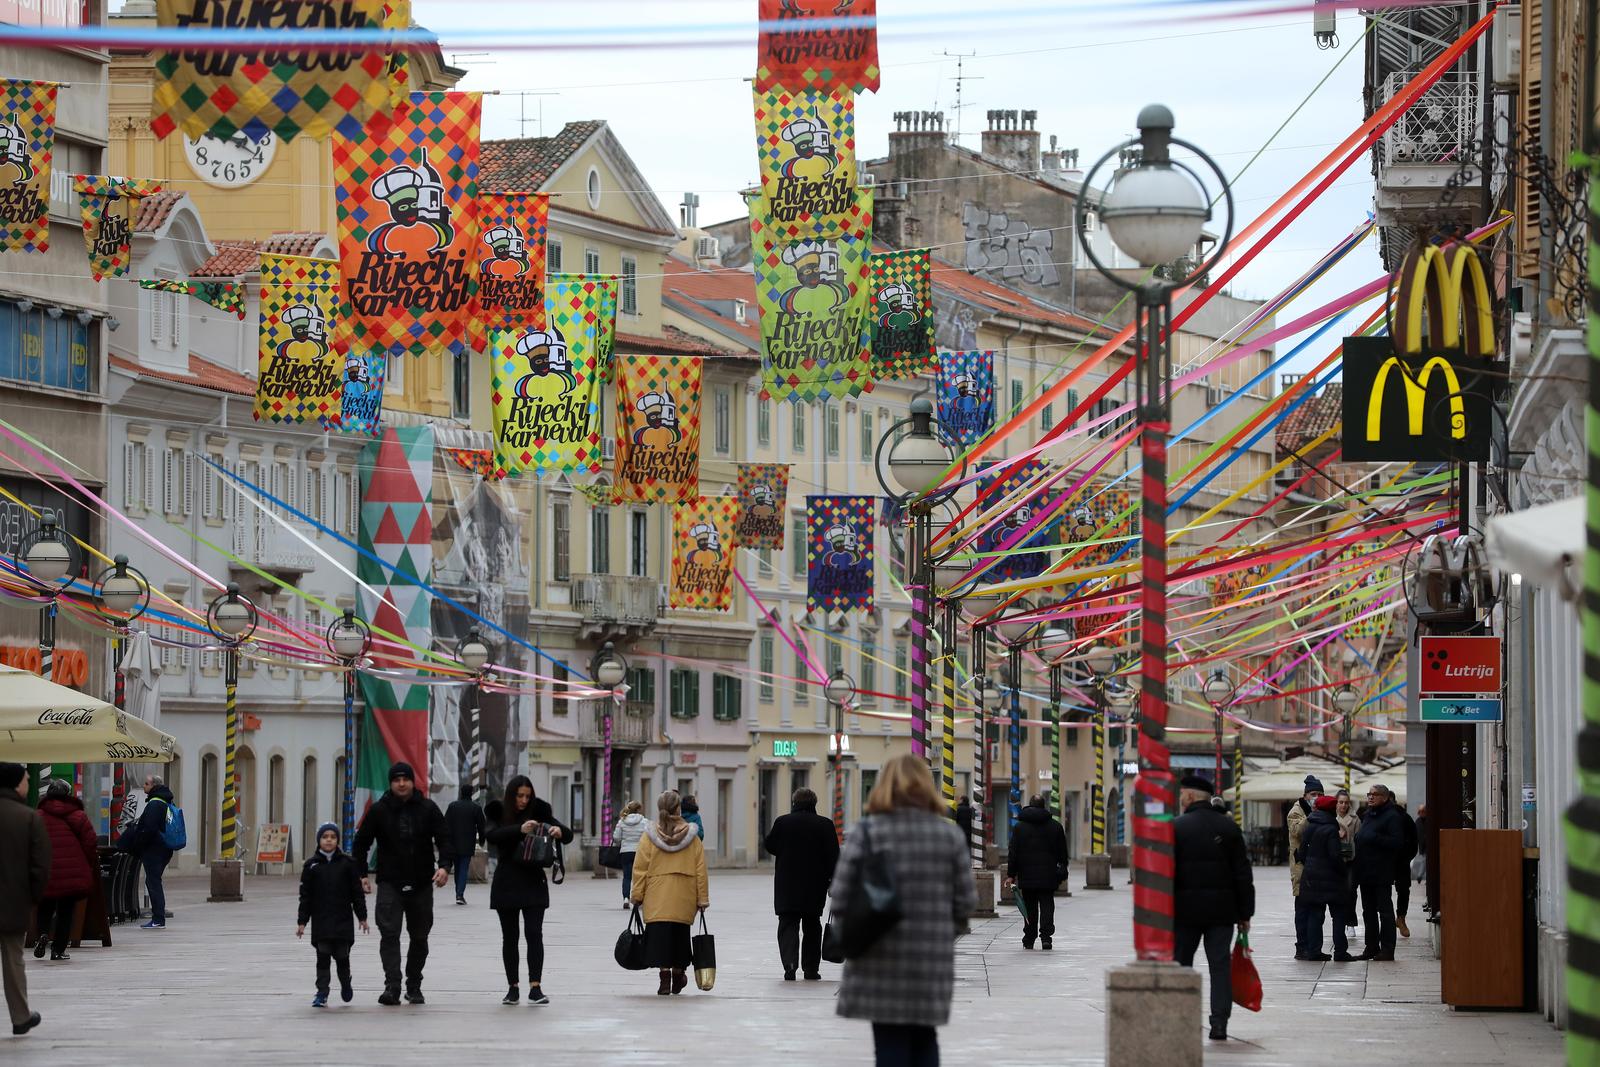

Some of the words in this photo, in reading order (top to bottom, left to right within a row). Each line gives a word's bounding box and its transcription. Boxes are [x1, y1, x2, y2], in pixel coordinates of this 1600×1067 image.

[196, 147, 207, 165] 8
[252, 146, 264, 163] 4
[211, 160, 222, 177] 7
[224, 162, 235, 182] 6
[240, 159, 251, 178] 5
[769, 187, 853, 222] karneval
[347, 272, 470, 317] karneval
[765, 328, 863, 370] karneval
[260, 372, 339, 398] karneval
[508, 394, 587, 429] Riječki
[500, 413, 590, 449] karneval
[621, 460, 693, 485] karneval
[1445, 664, 1494, 679] Lutrija
